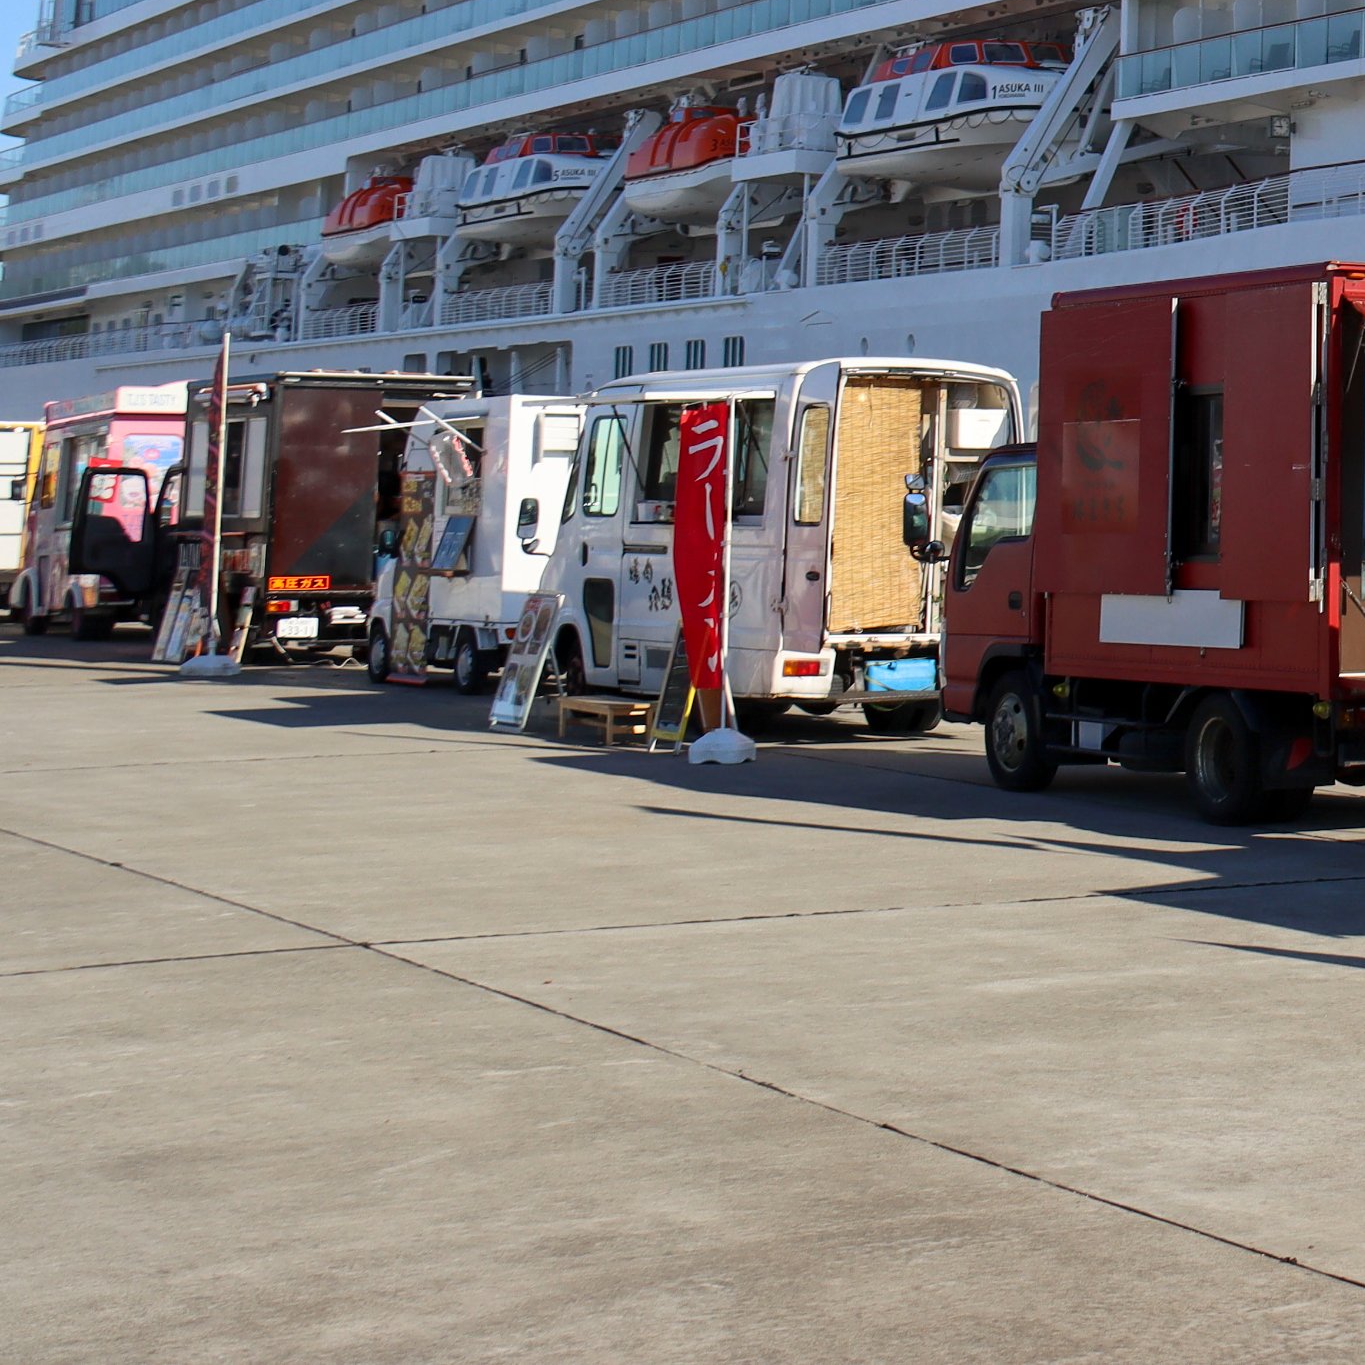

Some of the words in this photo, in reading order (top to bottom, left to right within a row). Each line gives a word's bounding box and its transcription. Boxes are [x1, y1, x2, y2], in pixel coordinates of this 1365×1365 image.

[992, 85, 997, 100] 1
[999, 83, 1031, 93] ASUKA
[1034, 84, 1044, 93] III
[552, 169, 560, 182] 5
[272, 578, 325, 589] 高圧ガス
